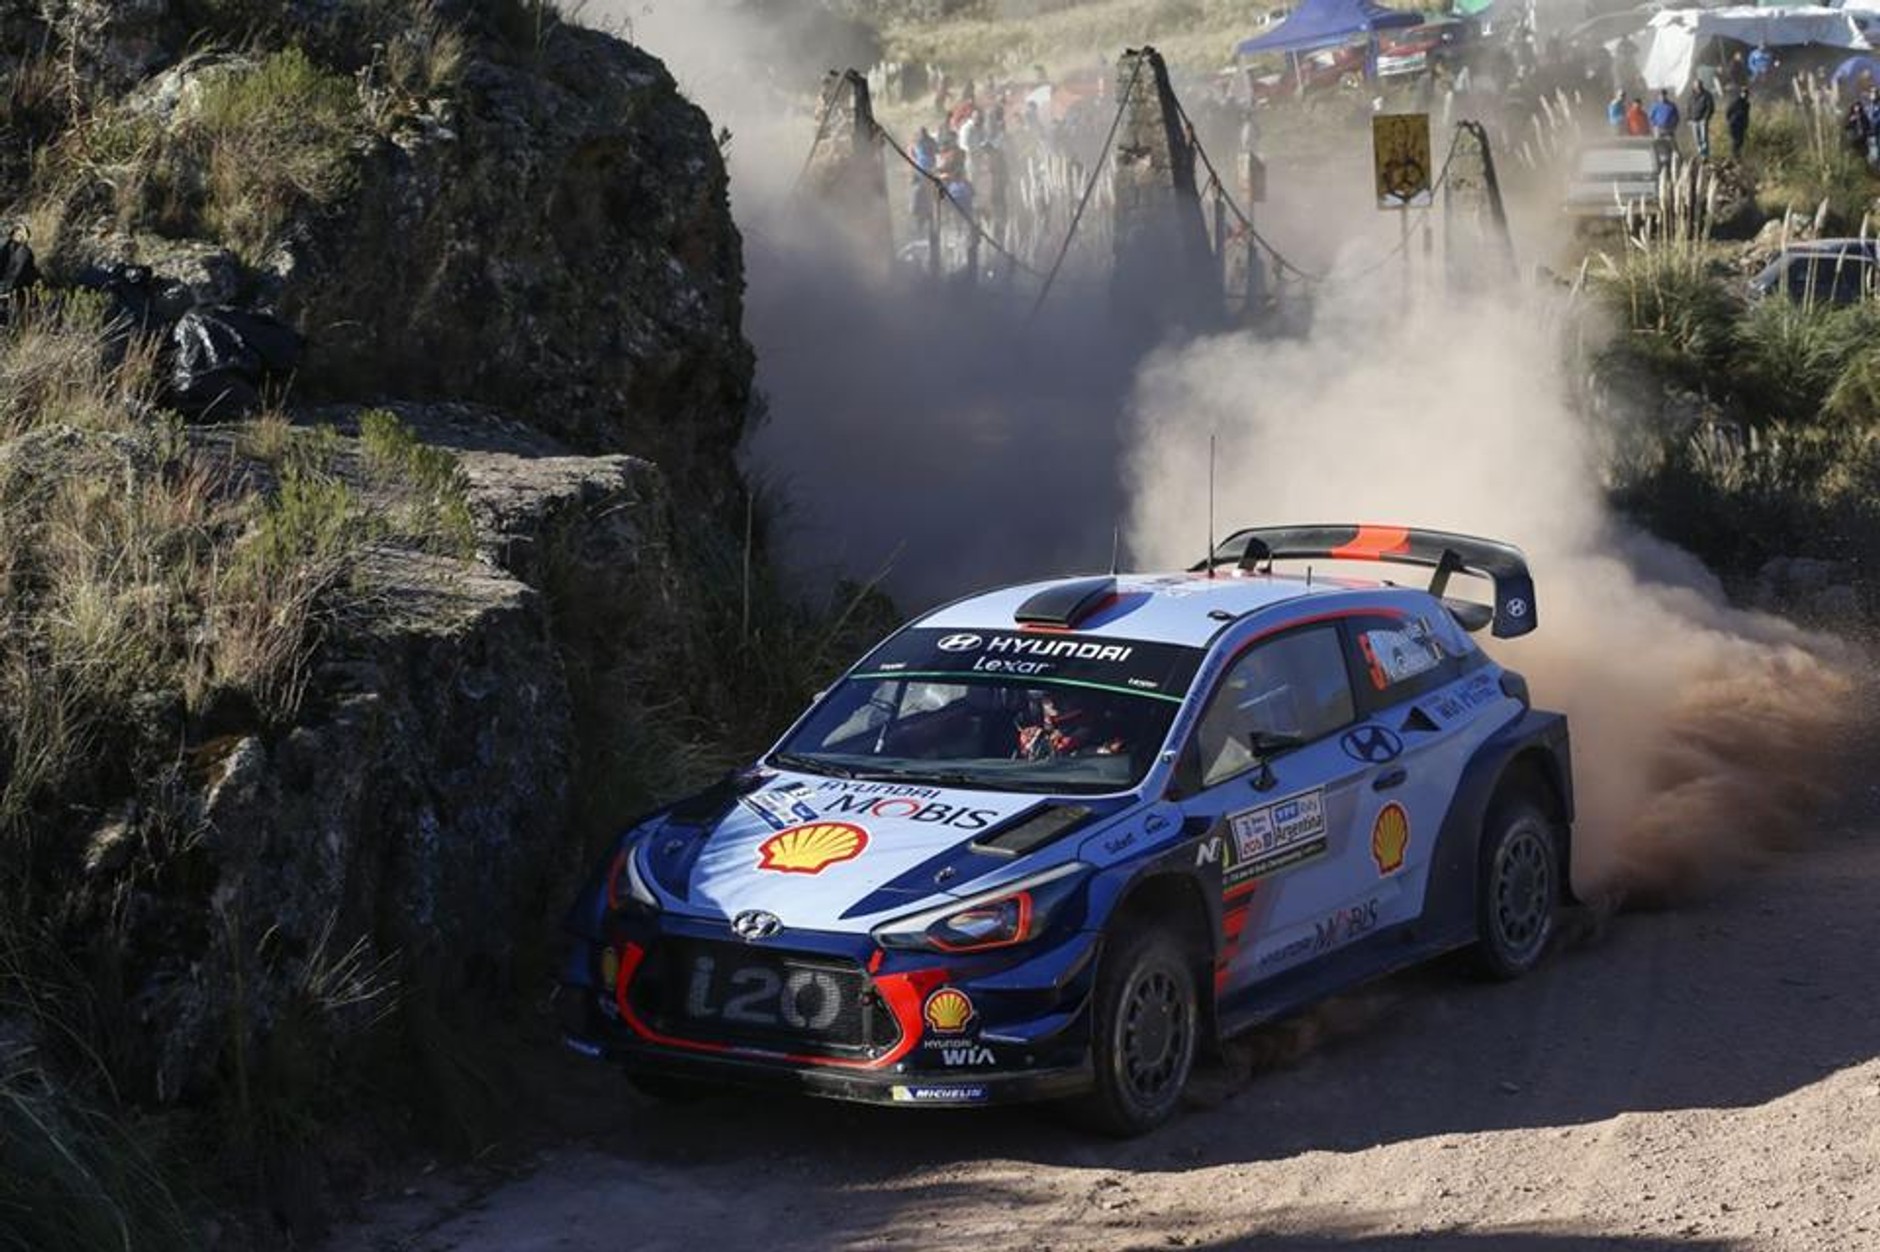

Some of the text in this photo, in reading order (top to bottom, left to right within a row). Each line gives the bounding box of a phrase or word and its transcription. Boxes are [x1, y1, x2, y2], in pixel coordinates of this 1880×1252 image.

[986, 636, 1133, 662] HYUNDAI
[973, 656, 1050, 675] Lexar
[817, 780, 942, 799] HYUNDAI
[823, 795, 999, 830] MOBIS
[1314, 897, 1379, 954] MOBIS
[689, 955, 841, 1030] i20
[924, 1039, 973, 1049] HYUNDAI
[915, 1088, 983, 1099] MICHELIN
